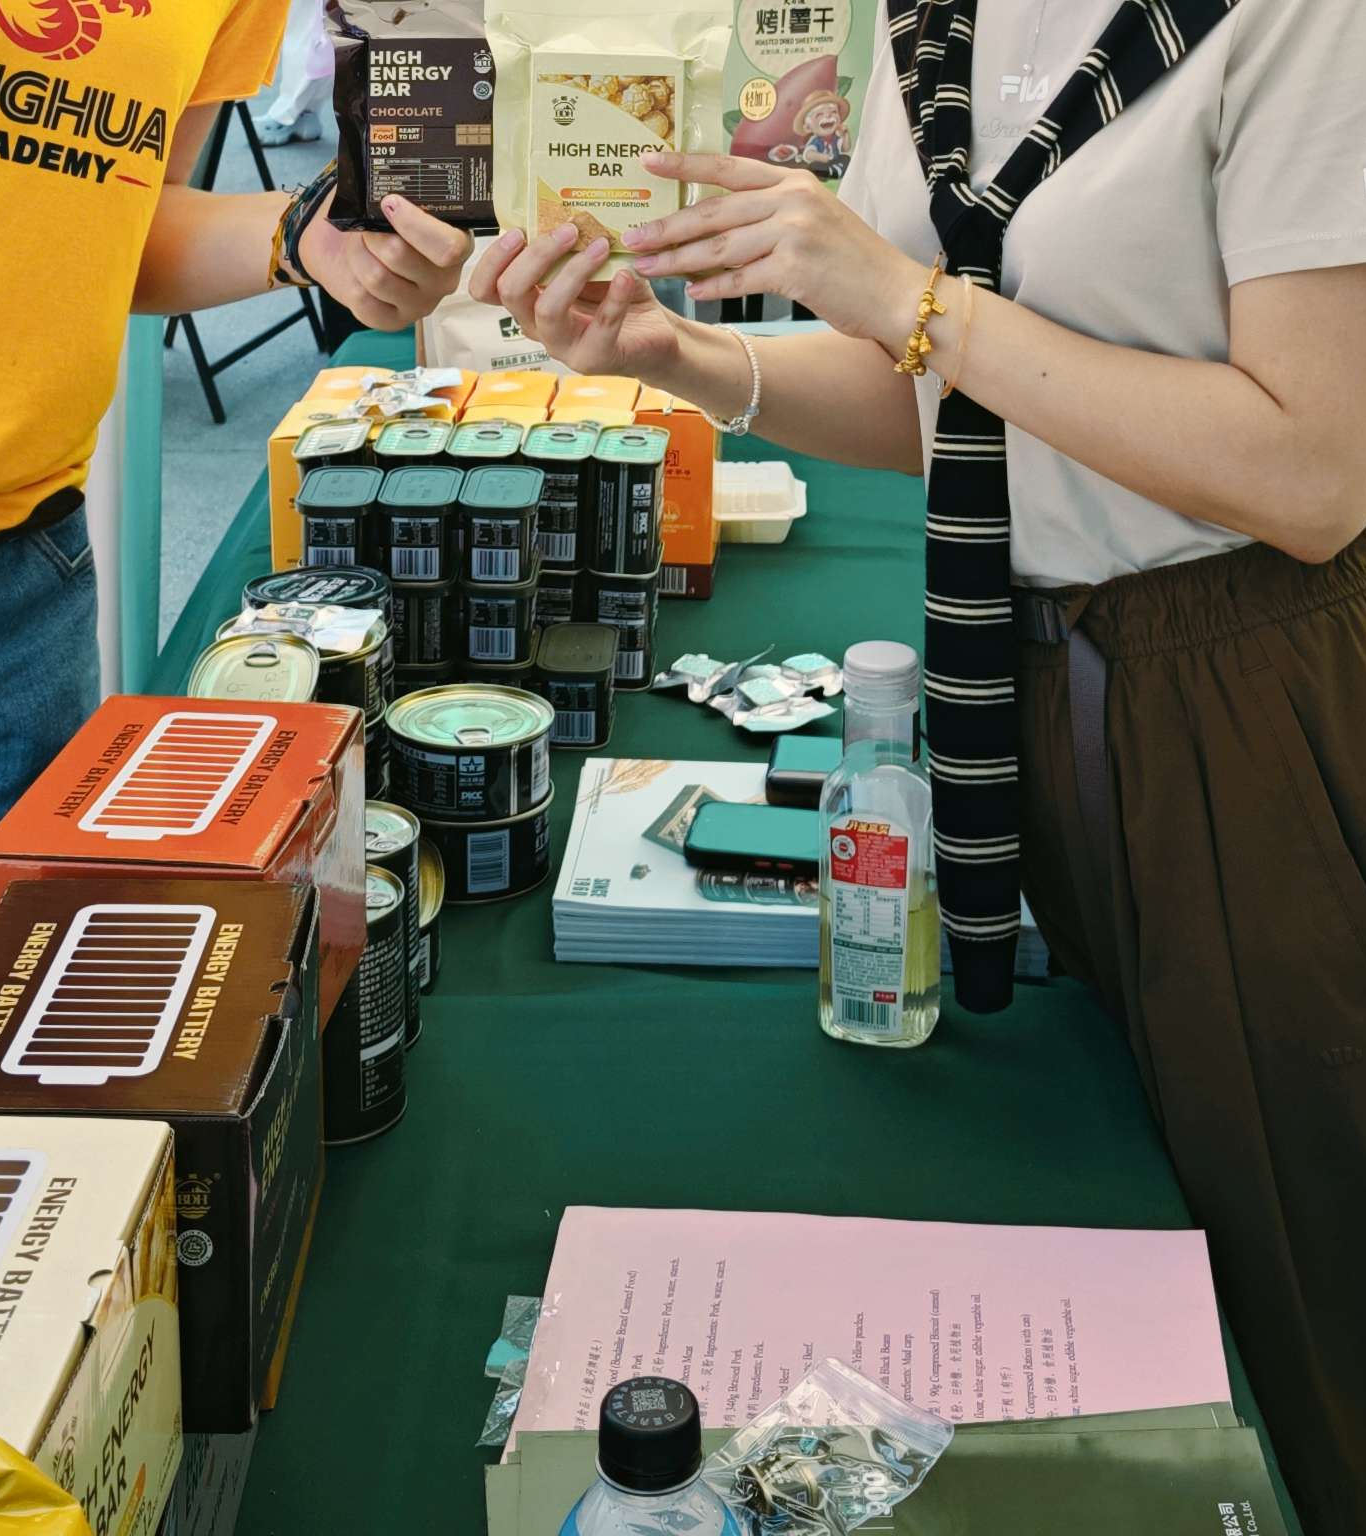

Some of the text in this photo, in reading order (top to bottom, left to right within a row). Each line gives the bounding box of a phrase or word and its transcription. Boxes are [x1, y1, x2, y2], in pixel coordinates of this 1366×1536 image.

[370, 51, 421, 64] HIGH
[370, 66, 452, 81] ENERGY
[370, 82, 411, 96] BAR
[1000, 74, 1050, 102] FILA
[370, 107, 443, 117] CHOCOLATE
[370, 147, 387, 155] 120
[548, 143, 664, 157] HIGH ENERGY
[588, 163, 623, 177] BAR
[54, 723, 143, 818] ENERGY BATTERY
[221, 730, 298, 825] ENERGY BATTERY
[590, 878, 611, 897] SINCE
[8, 922, 58, 981] ENERGY
[173, 923, 243, 1060] ENERGY BATTERY
[15, 1177, 77, 1262] ENERGY
[616, 1315, 629, 1336] Brand
[971, 1304, 984, 1334] vegetable
[1061, 1308, 1075, 1339] vegetable
[930, 1318, 939, 1341] Biscuit
[852, 1341, 863, 1363] Yellow
[972, 1335, 983, 1356] edible
[1065, 1341, 1075, 1361] edible
[632, 1354, 643, 1369] Pork
[732, 1349, 742, 1365] Pork
[880, 1357, 890, 1375] Black
[902, 1349, 912, 1365] Mud
[930, 1342, 942, 1383] Compressed
[779, 1367, 790, 1384] Beef
[901, 1367, 914, 1403] gredients:
[930, 1384, 942, 1397] 90g
[974, 1378, 983, 1398] white
[1026, 1372, 1037, 1414] Compressed
[1069, 1385, 1078, 1404] white
[103, 1317, 155, 1487] ENERGY
[96, 1456, 126, 1536] BAR
